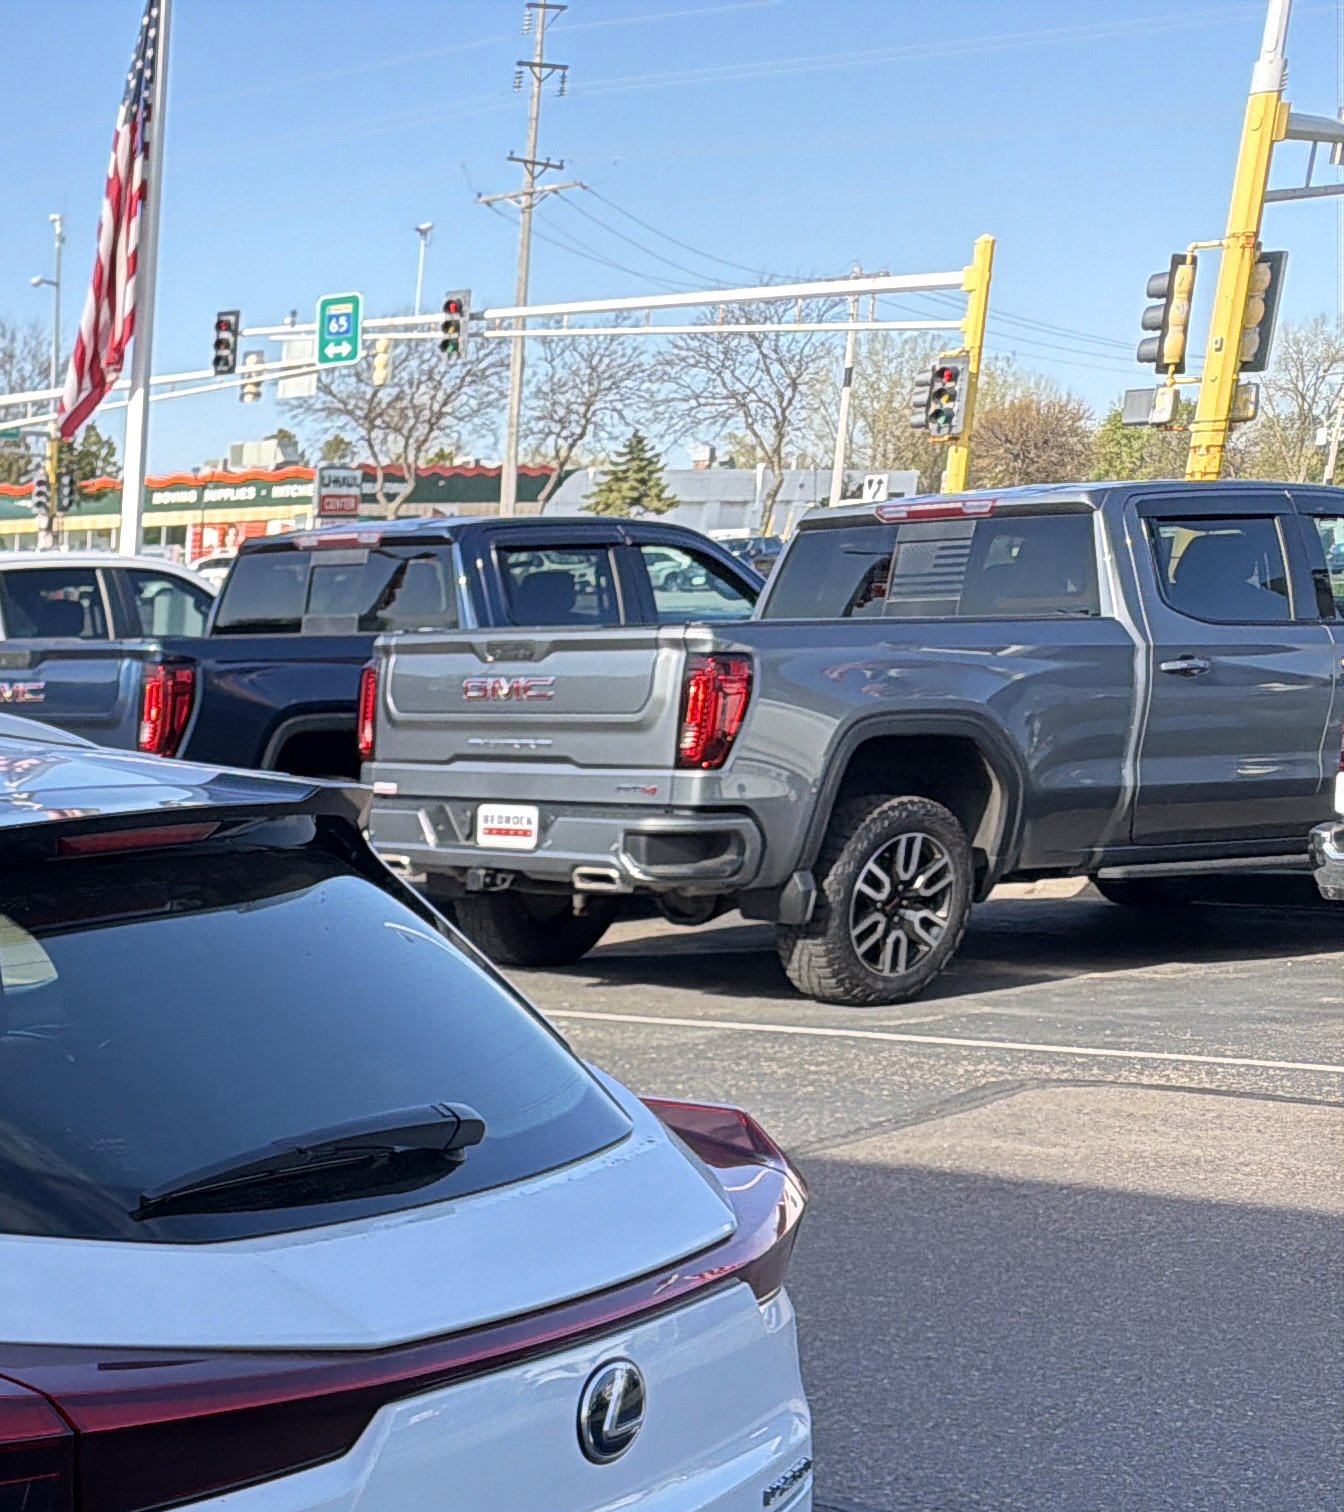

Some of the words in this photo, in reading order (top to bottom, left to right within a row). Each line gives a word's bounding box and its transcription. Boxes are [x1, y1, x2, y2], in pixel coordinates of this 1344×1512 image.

[328, 315, 349, 333] 65
[152, 490, 198, 504] MOVING
[203, 485, 256, 502] SUPPLIES
[463, 676, 556, 701] GMC
